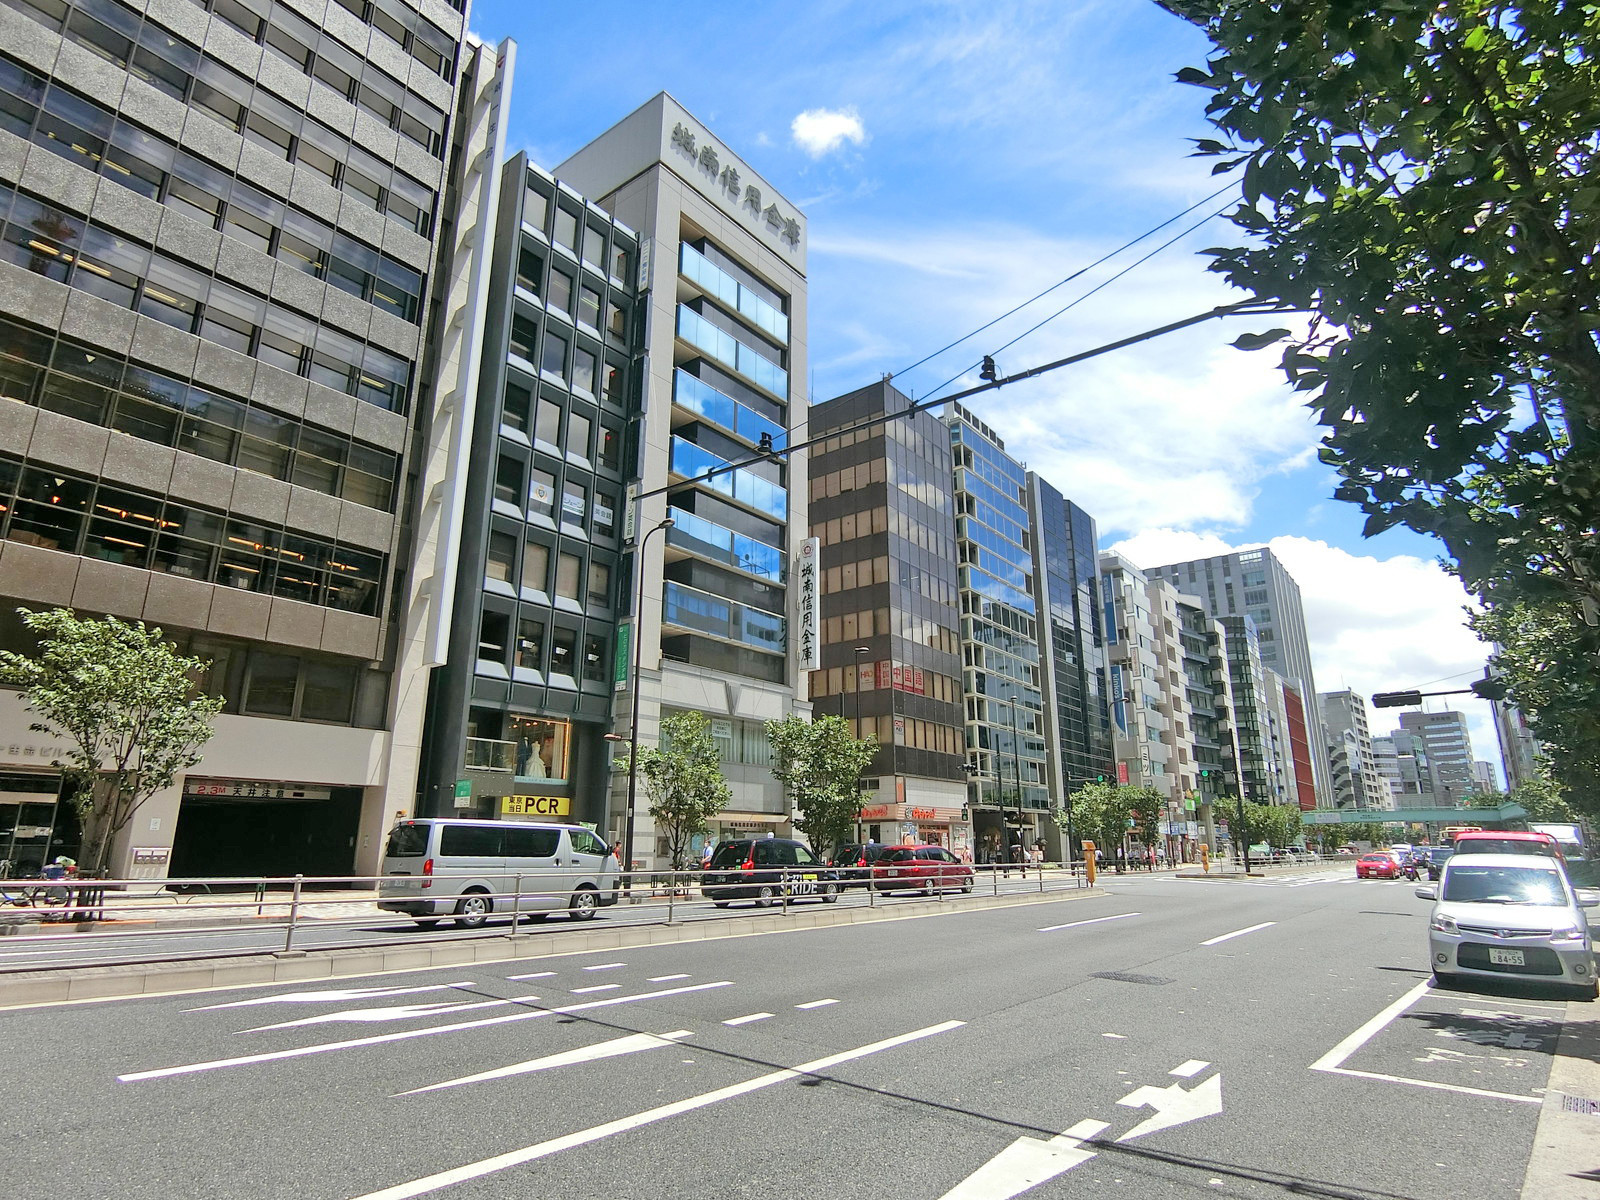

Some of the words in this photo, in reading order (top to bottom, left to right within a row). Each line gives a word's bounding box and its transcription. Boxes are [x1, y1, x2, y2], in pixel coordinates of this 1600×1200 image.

[672, 121, 801, 245] 城南信用金庫
[801, 562, 815, 666] 城南信用金庫
[893, 667, 922, 686] 中国語
[508, 796, 522, 805] 東京
[525, 797, 559, 814] PCR
[508, 805, 521, 813] 当日
